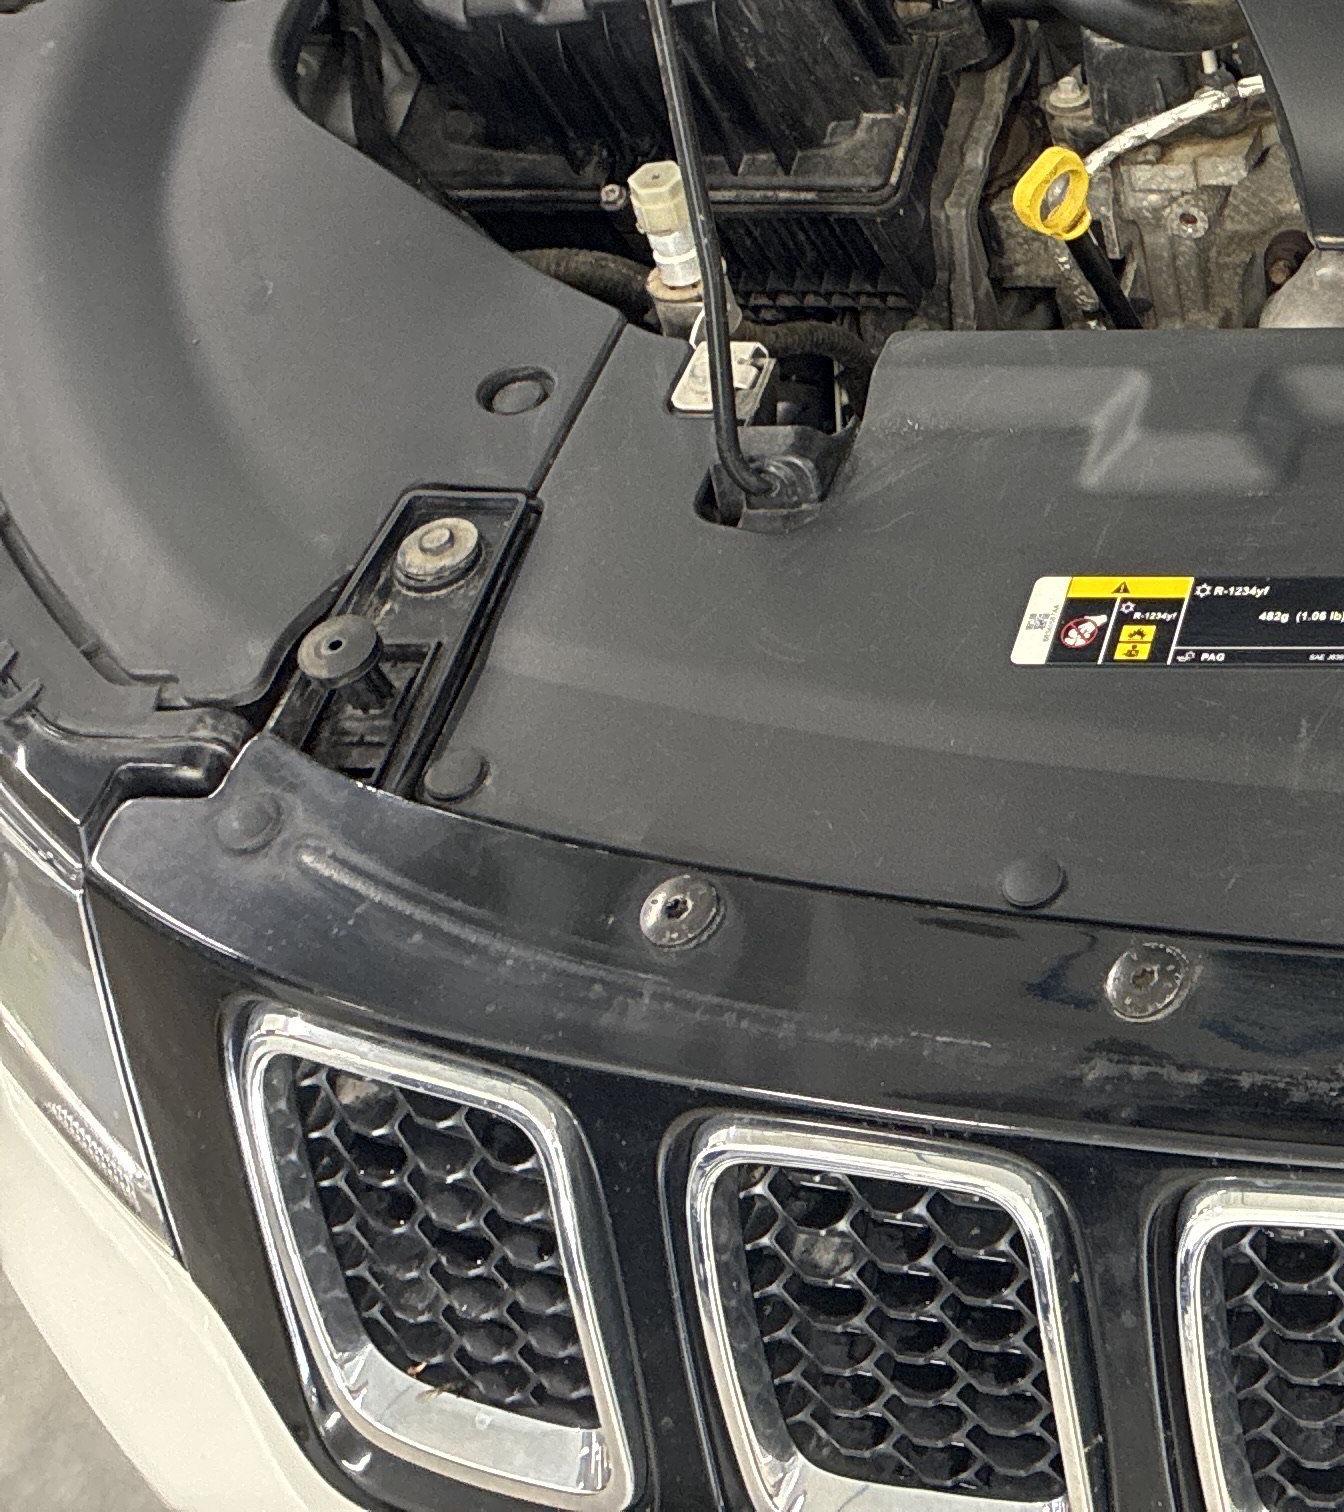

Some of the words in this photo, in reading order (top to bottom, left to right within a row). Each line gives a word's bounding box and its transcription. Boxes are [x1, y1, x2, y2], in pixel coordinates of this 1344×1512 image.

[1213, 584, 1271, 598] R-1234yf
[1132, 609, 1178, 623] R-1234yf
[1200, 652, 1226, 662] PAG
